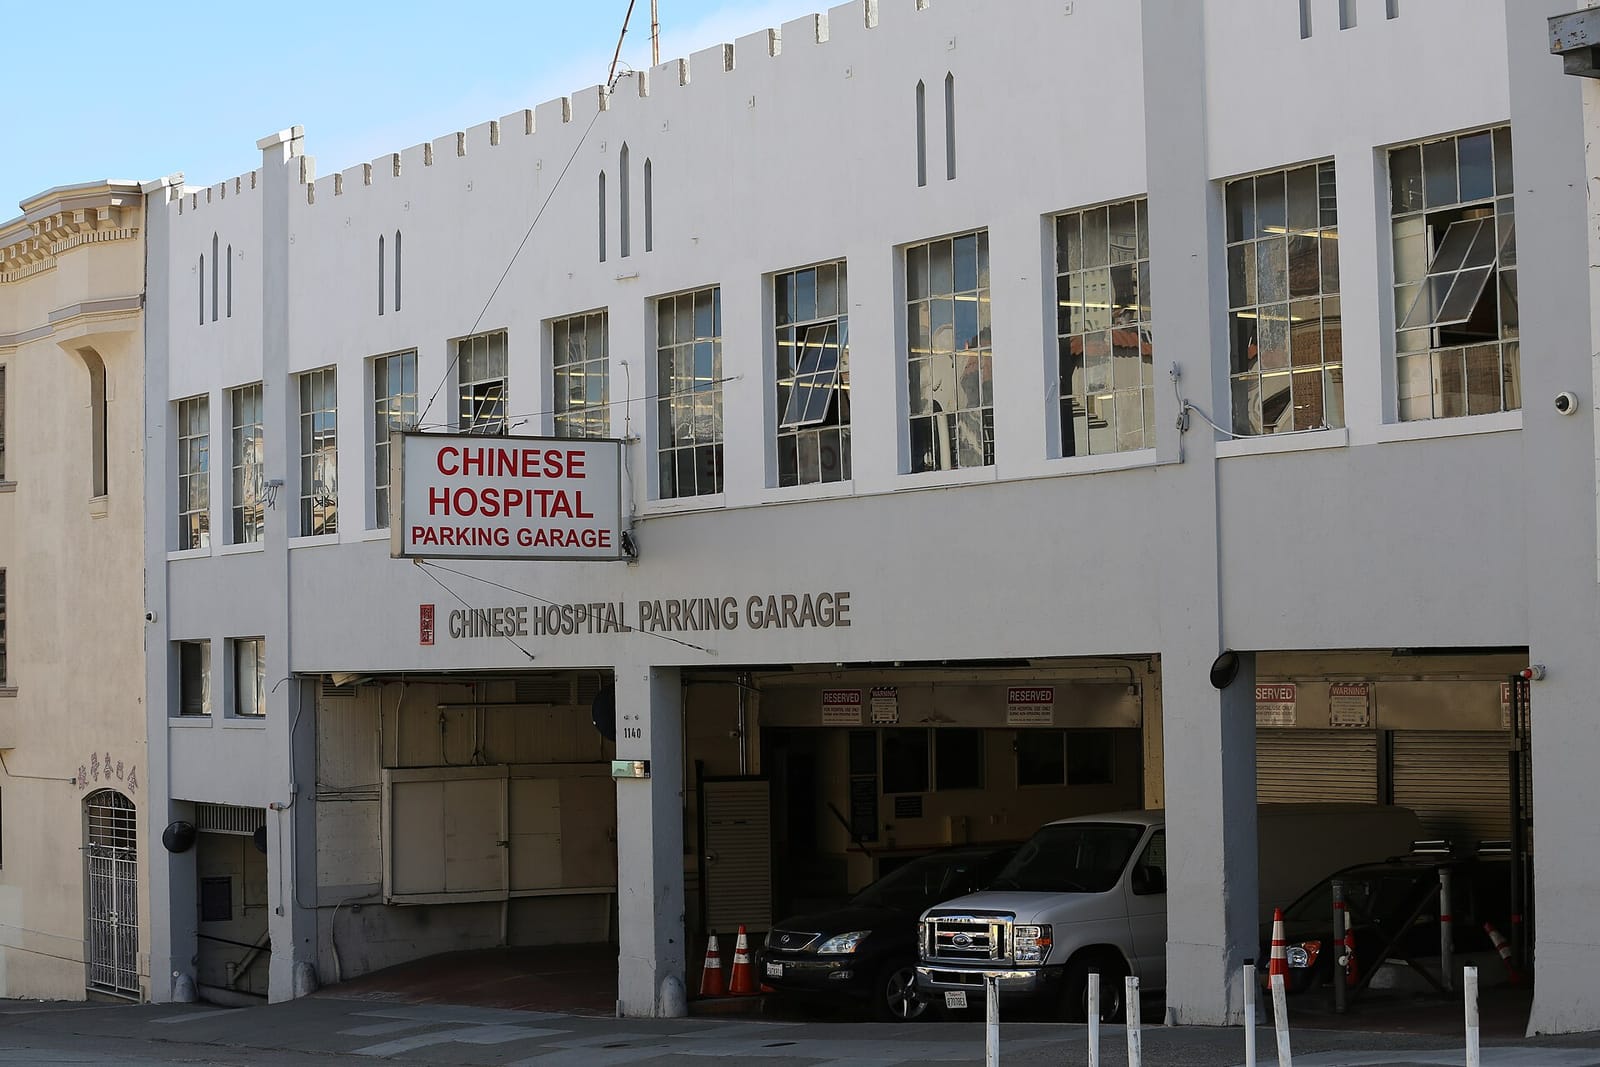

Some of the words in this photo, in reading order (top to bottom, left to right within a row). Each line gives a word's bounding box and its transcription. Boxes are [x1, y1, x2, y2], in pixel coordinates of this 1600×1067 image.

[437, 446, 586, 479] CHINESE
[429, 486, 594, 519] HOSPITAL
[411, 526, 510, 547] PARKING
[516, 528, 612, 548] GARAGE
[449, 607, 528, 639] CHINESE
[533, 602, 632, 635] HOSPITAL
[639, 597, 739, 632] PARKING
[746, 592, 851, 629] GARAGE
[1010, 690, 1052, 701] RESERVED
[1255, 688, 1293, 700] SERVED
[1332, 687, 1366, 695] WARNING
[824, 692, 860, 703] RESERVED
[624, 727, 641, 739] 1140
